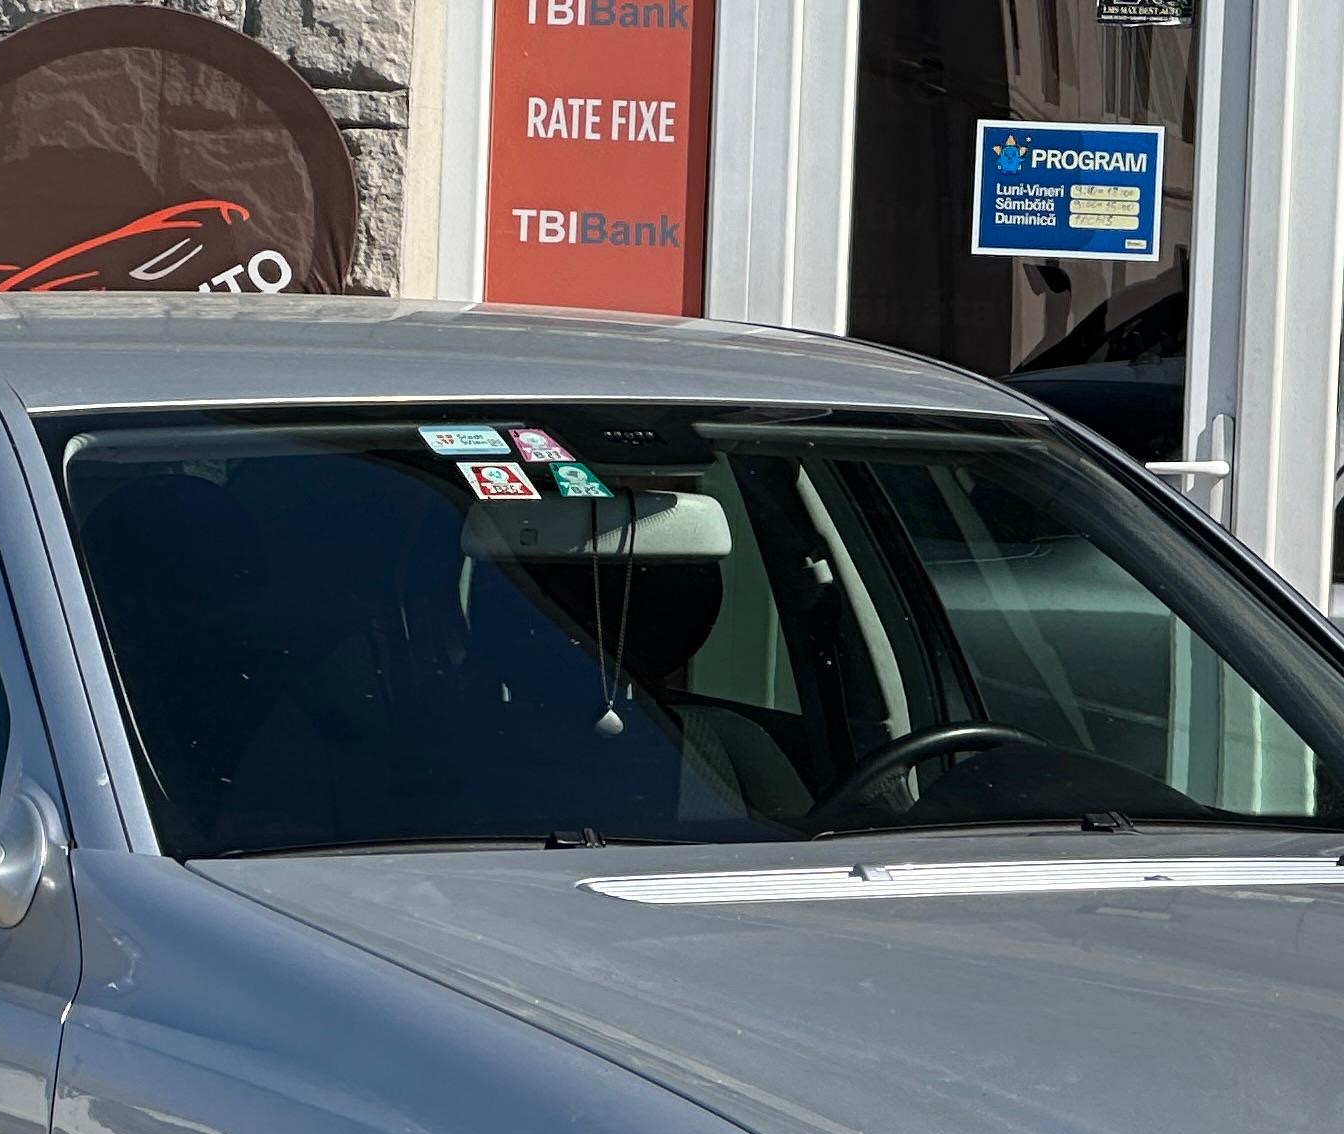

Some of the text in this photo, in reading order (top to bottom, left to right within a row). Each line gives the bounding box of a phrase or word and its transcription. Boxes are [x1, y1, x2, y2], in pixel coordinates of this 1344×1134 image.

[527, 96, 676, 143] RATE FIXE
[1031, 149, 1148, 173] PROGRAM
[996, 183, 1065, 198] Luni-Vineri
[995, 197, 1055, 212] Sâmbătă
[512, 208, 680, 248] TBIBank
[995, 212, 1057, 227] Duminică
[198, 250, 293, 293] TO
